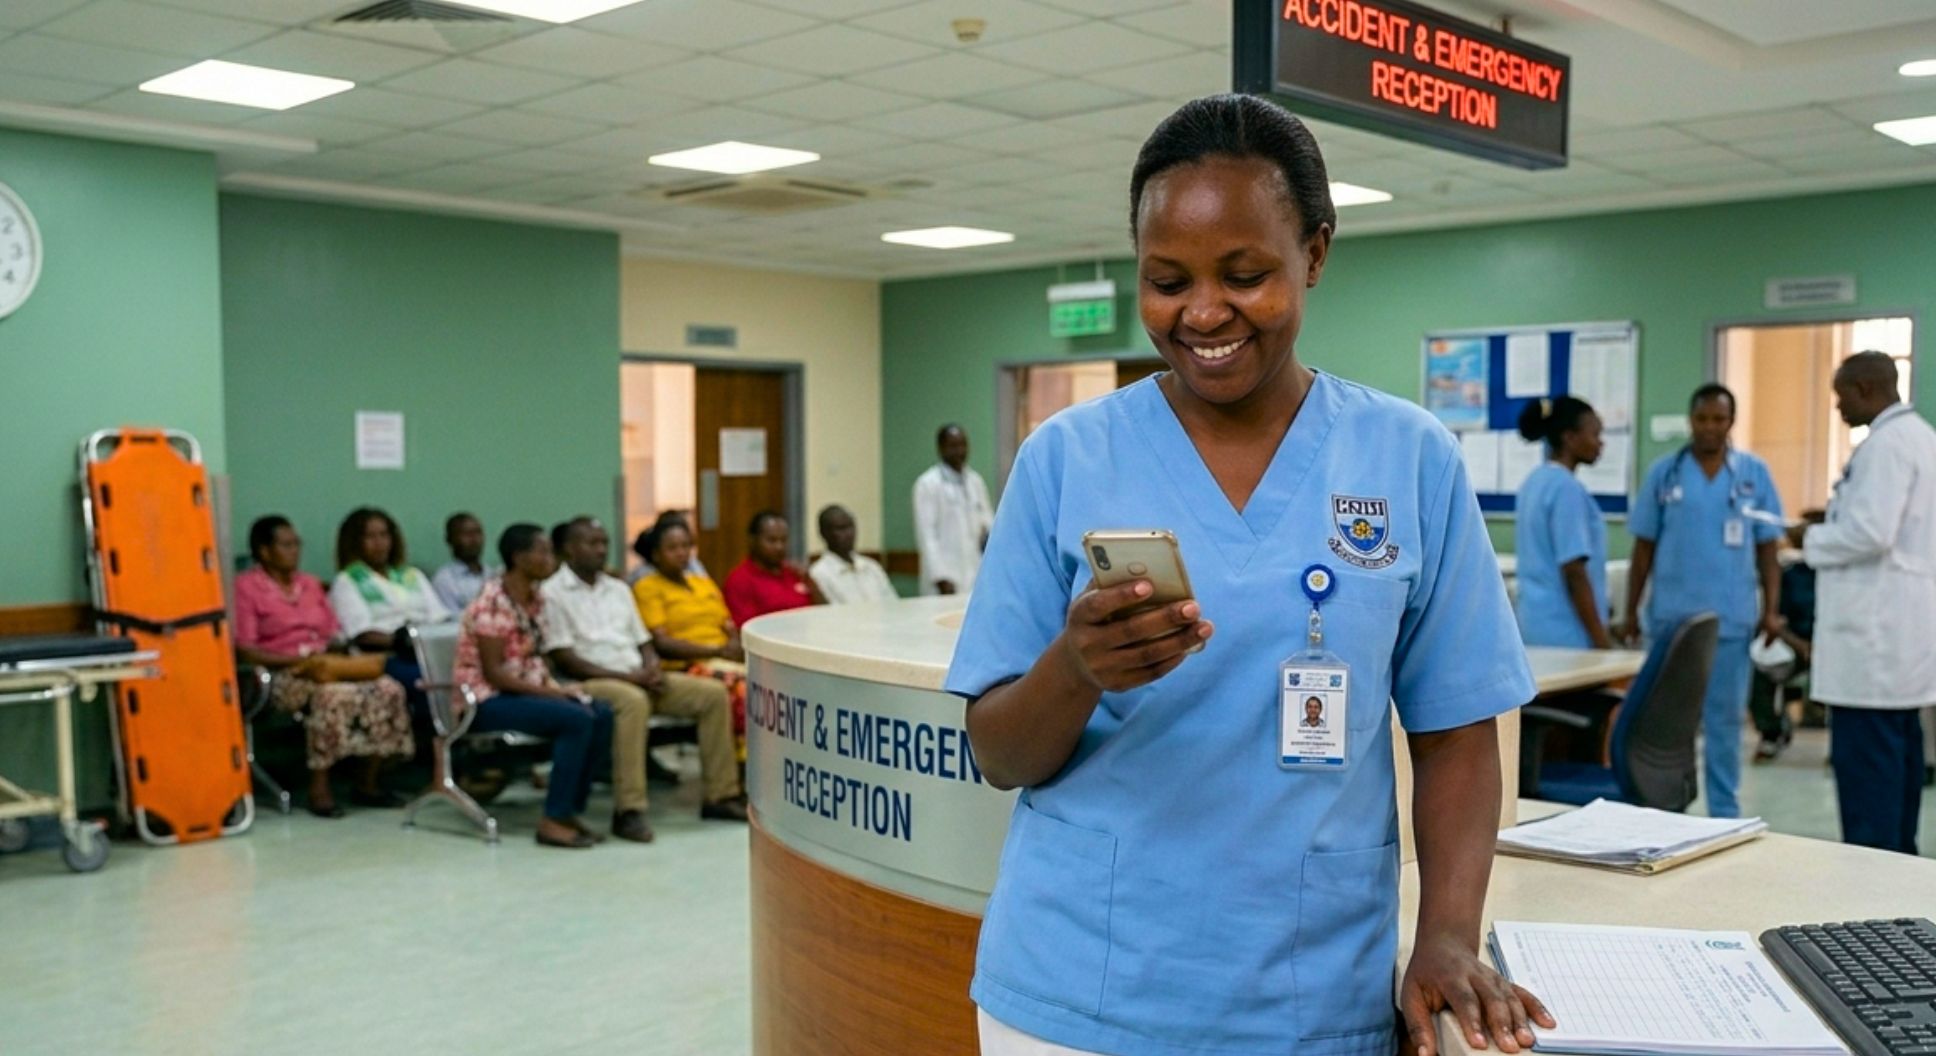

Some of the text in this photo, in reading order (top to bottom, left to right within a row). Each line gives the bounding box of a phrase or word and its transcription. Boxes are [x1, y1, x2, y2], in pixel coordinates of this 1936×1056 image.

[1284, 0, 1562, 101] ACCIDENT & EMERGENCY
[1372, 61, 1496, 128] RECEPTION
[814, 703, 828, 751] &
[784, 757, 911, 842] RECEPTION
